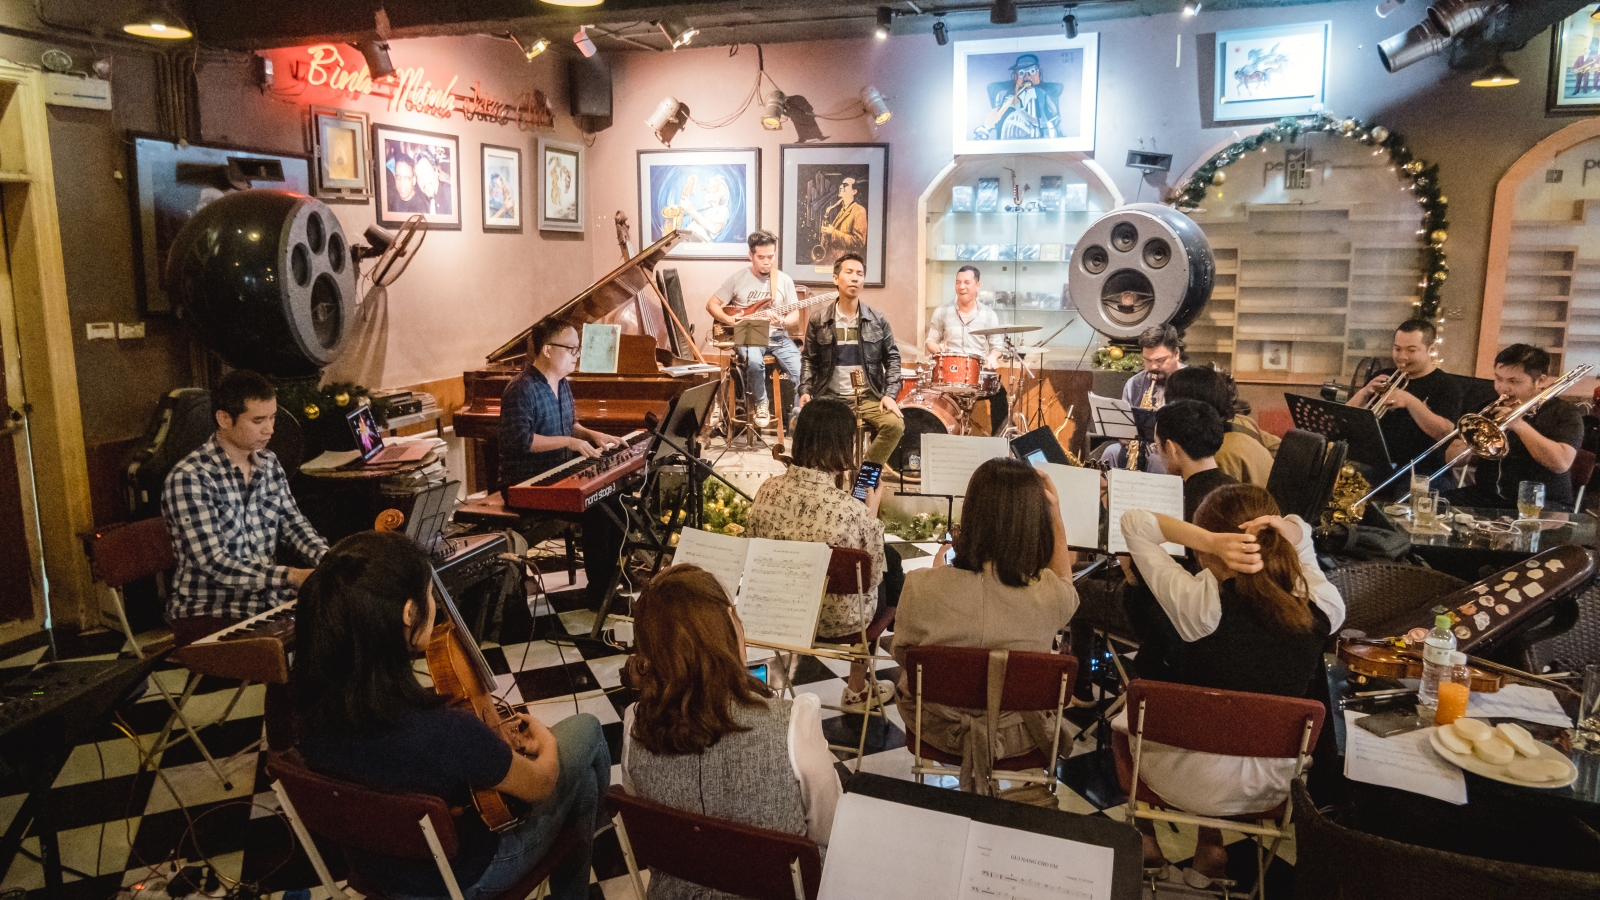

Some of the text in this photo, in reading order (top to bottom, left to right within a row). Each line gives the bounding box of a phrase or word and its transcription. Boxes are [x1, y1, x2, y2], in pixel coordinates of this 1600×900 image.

[391, 67, 458, 108] Minh
[585, 482, 616, 507] nord stage 3
